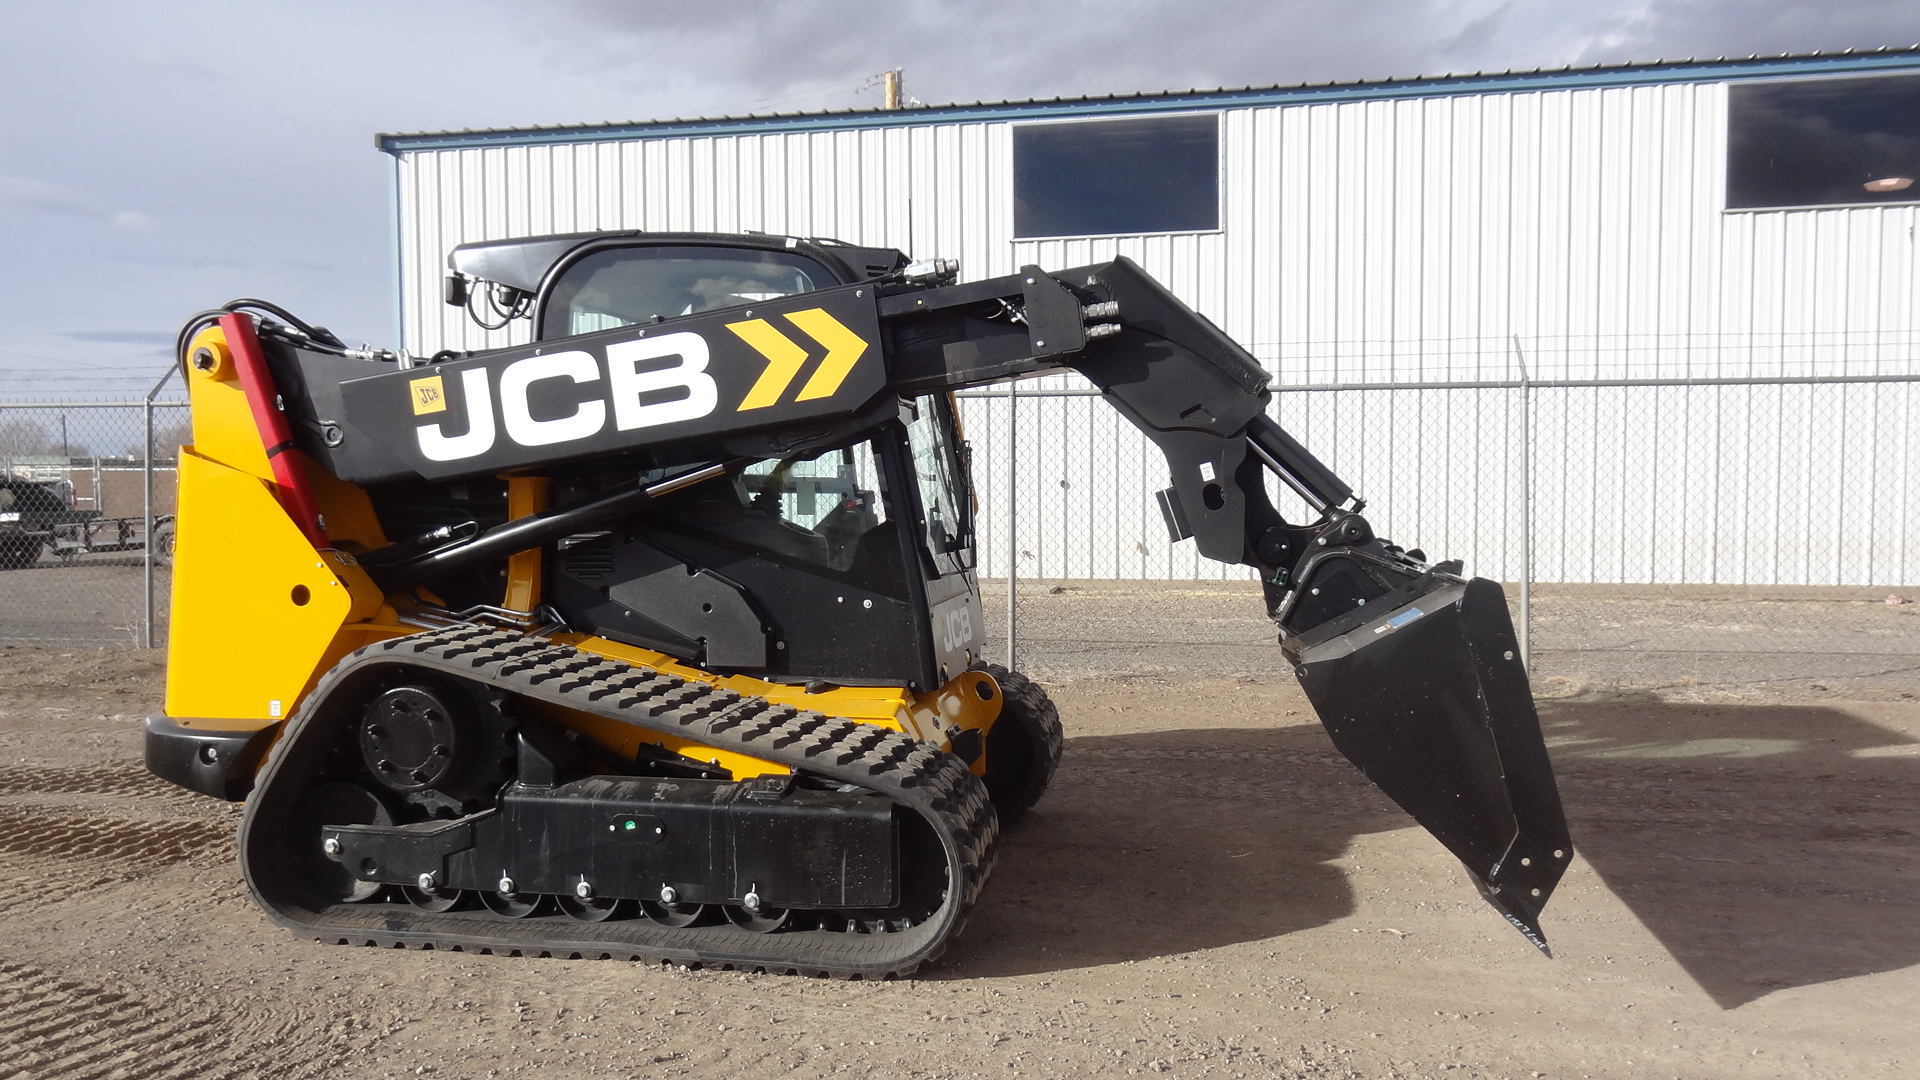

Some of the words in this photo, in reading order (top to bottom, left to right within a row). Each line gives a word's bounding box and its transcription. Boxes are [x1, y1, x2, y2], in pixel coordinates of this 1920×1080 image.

[416, 331, 718, 461] JCB
[420, 388, 439, 404] JCB
[943, 606, 973, 653] JCB
